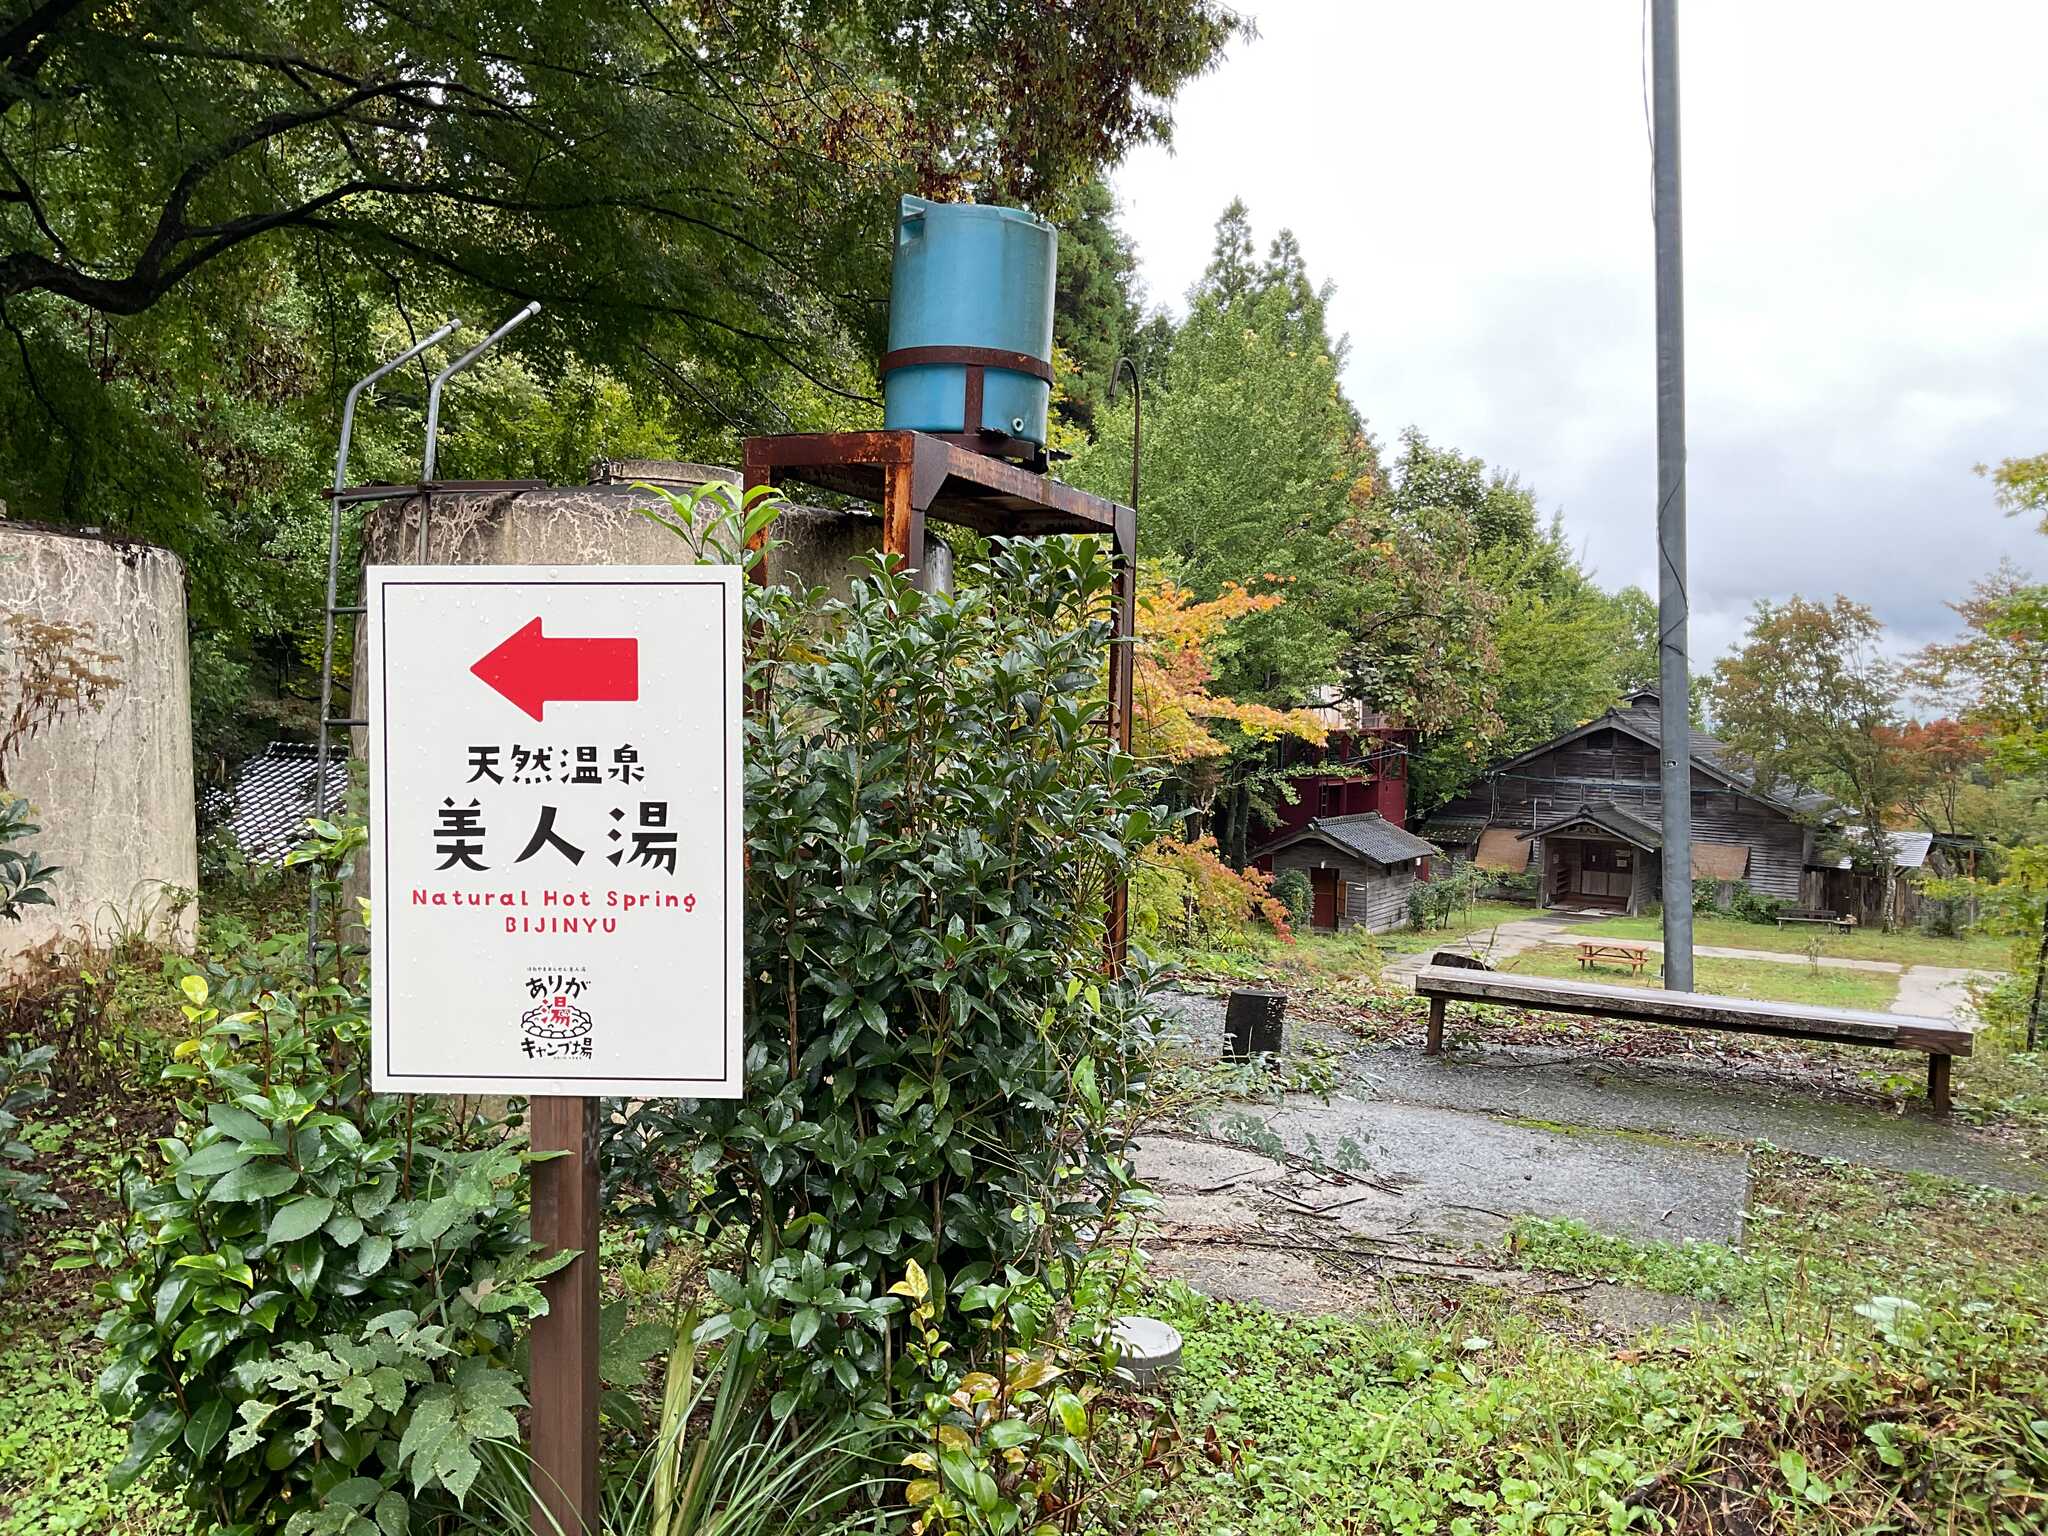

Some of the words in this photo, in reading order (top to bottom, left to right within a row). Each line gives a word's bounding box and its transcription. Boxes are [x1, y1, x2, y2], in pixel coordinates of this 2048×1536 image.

[467, 744, 645, 785] 天然温泉
[433, 797, 678, 876] 美人湯
[412, 890, 529, 907] Natural
[544, 890, 590, 907] Hot
[606, 891, 697, 912] Spring
[505, 917, 617, 934] BIJINYU
[525, 974, 592, 999] ありが
[520, 1037, 593, 1060] キャンプ場
